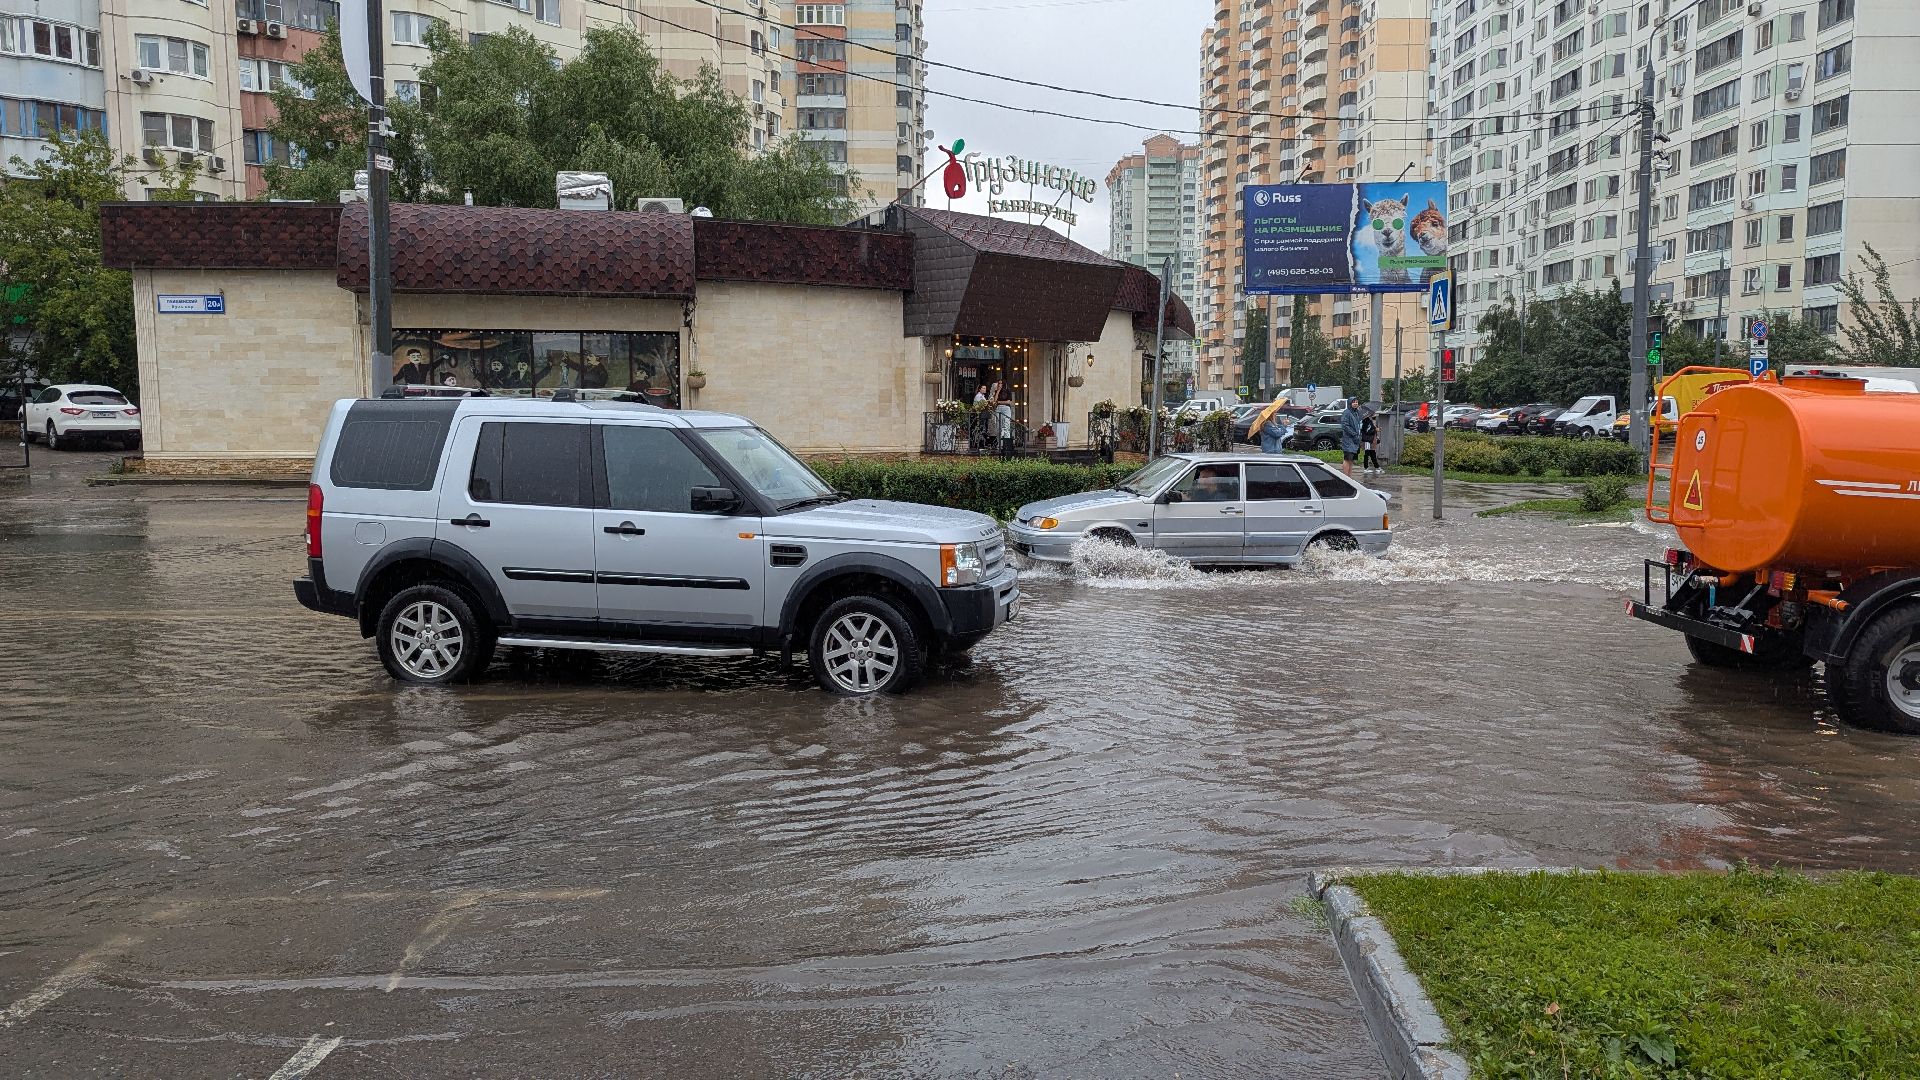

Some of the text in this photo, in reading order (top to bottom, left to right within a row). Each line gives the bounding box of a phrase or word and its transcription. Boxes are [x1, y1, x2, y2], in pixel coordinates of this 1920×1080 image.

[964, 152, 1098, 203] Грузинские
[1272, 192, 1302, 204] Russ
[1253, 217, 1297, 225] ЛЬГОТЫ
[1254, 225, 1343, 234] НА РАЗМЕЩЕНИЕ
[1267, 268, 1289, 277] (495)
[1753, 360, 1764, 375] P
